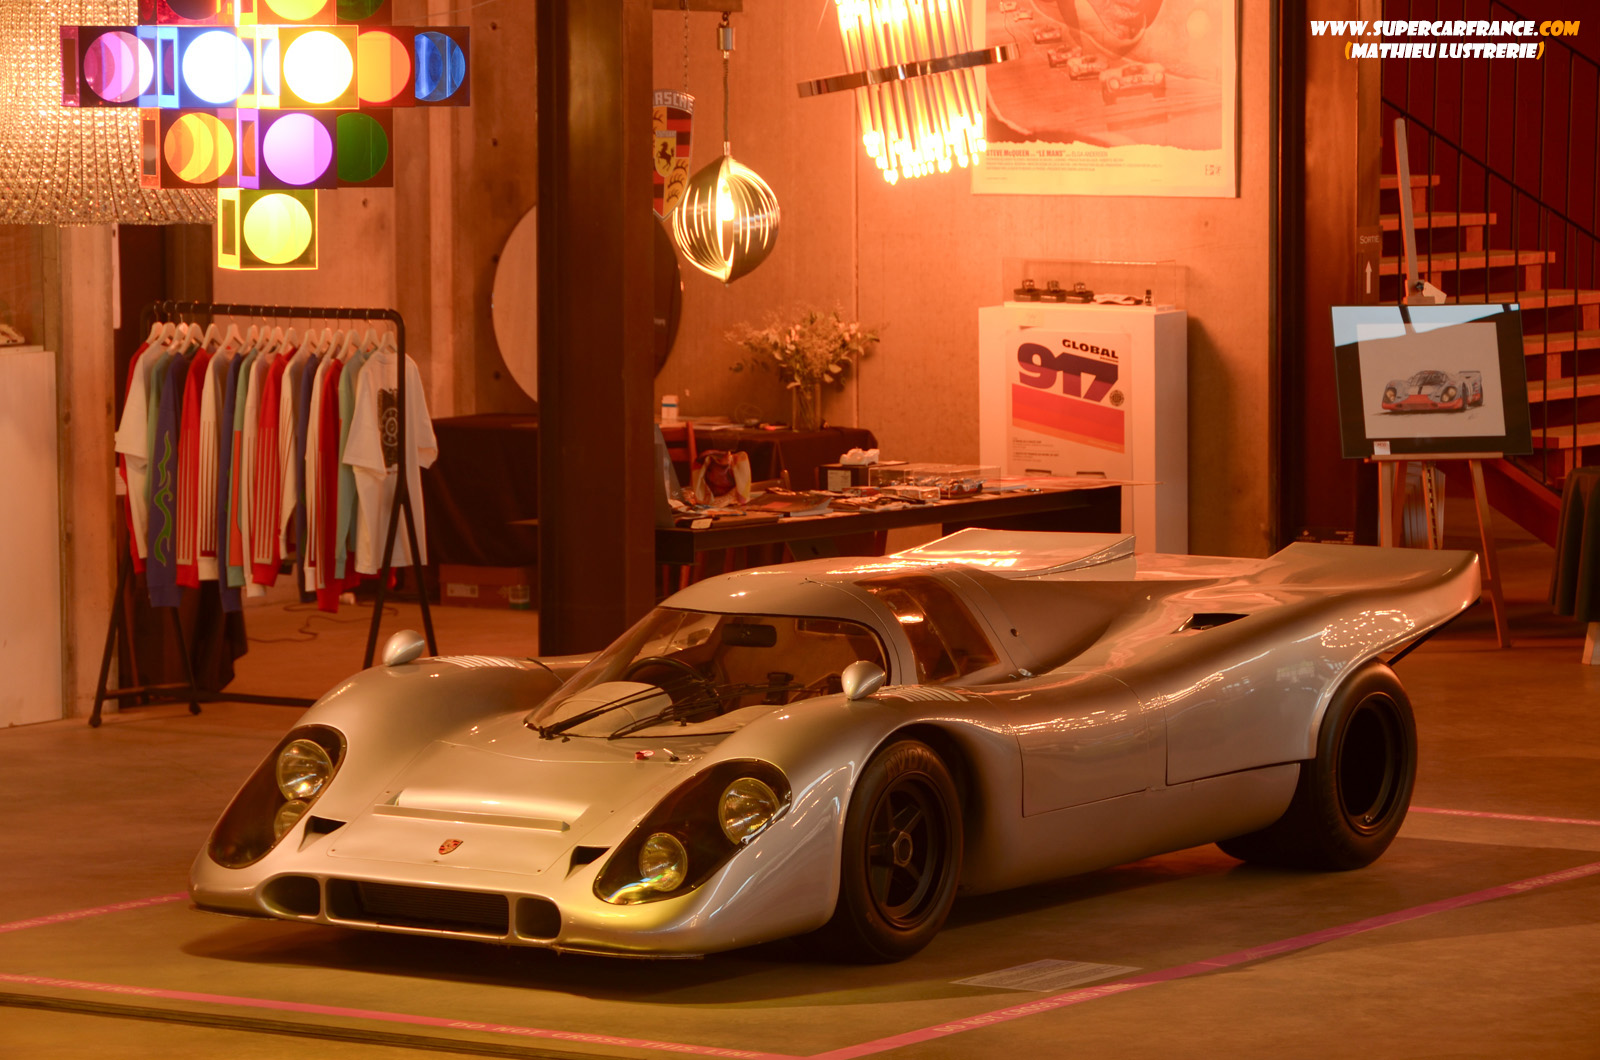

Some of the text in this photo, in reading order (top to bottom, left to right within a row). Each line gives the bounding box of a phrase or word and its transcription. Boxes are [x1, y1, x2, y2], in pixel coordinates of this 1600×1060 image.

[654, 91, 694, 111] RSCHE
[1062, 339, 1118, 358] GLOBAL
[1017, 342, 1118, 402] 917
[493, 1026, 549, 1035] NOT
[552, 1033, 632, 1045] CROSS
[641, 1041, 698, 1051] THIS
[704, 1049, 765, 1058] LINE
